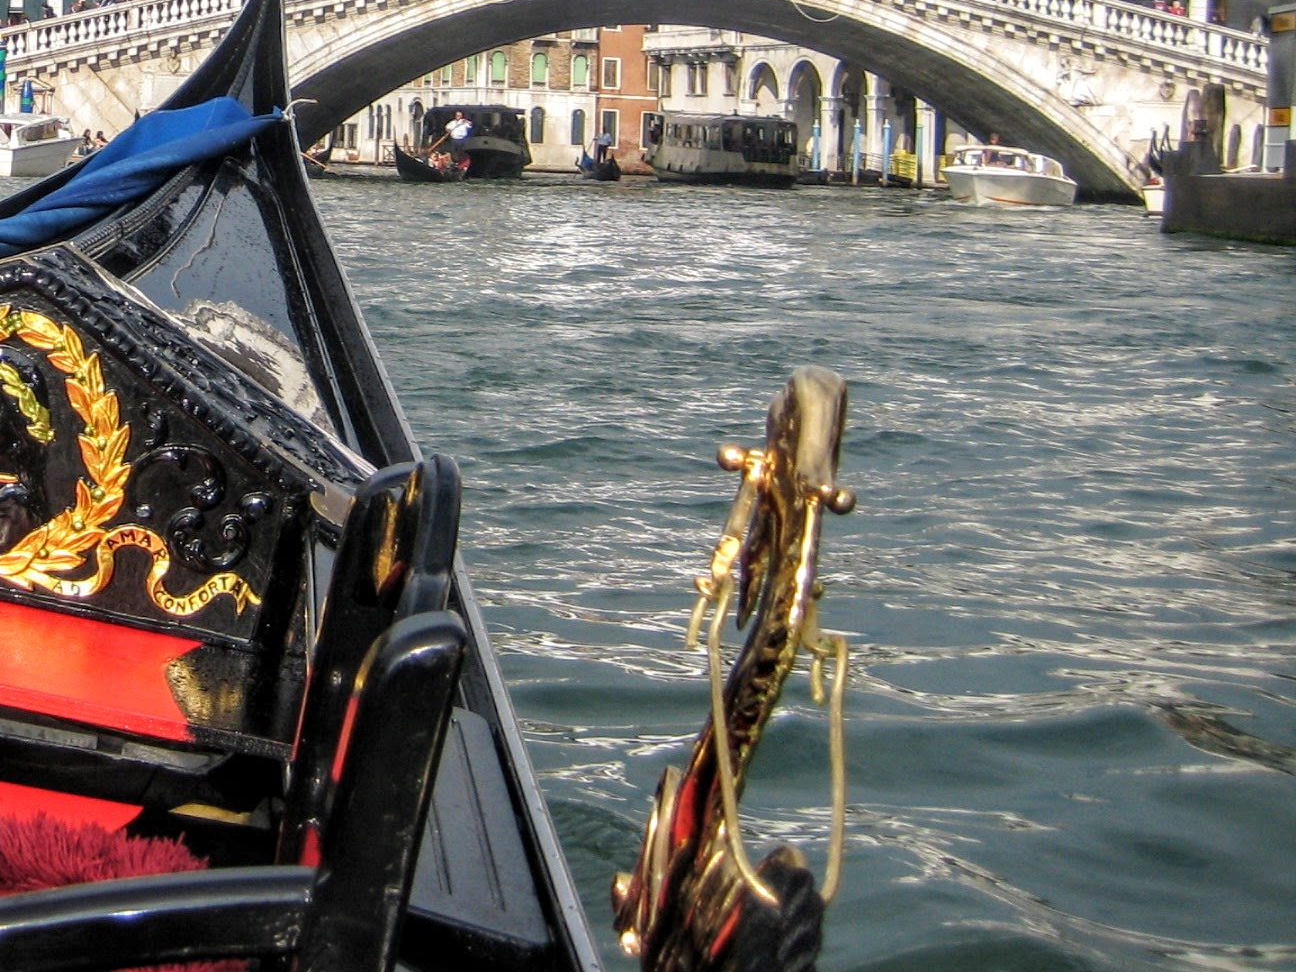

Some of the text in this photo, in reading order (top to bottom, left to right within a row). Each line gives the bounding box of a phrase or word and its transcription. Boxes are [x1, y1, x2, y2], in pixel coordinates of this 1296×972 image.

[53, 580, 81, 596] AD
[106, 529, 167, 562] AMAR
[155, 576, 244, 613] CONFORTA
